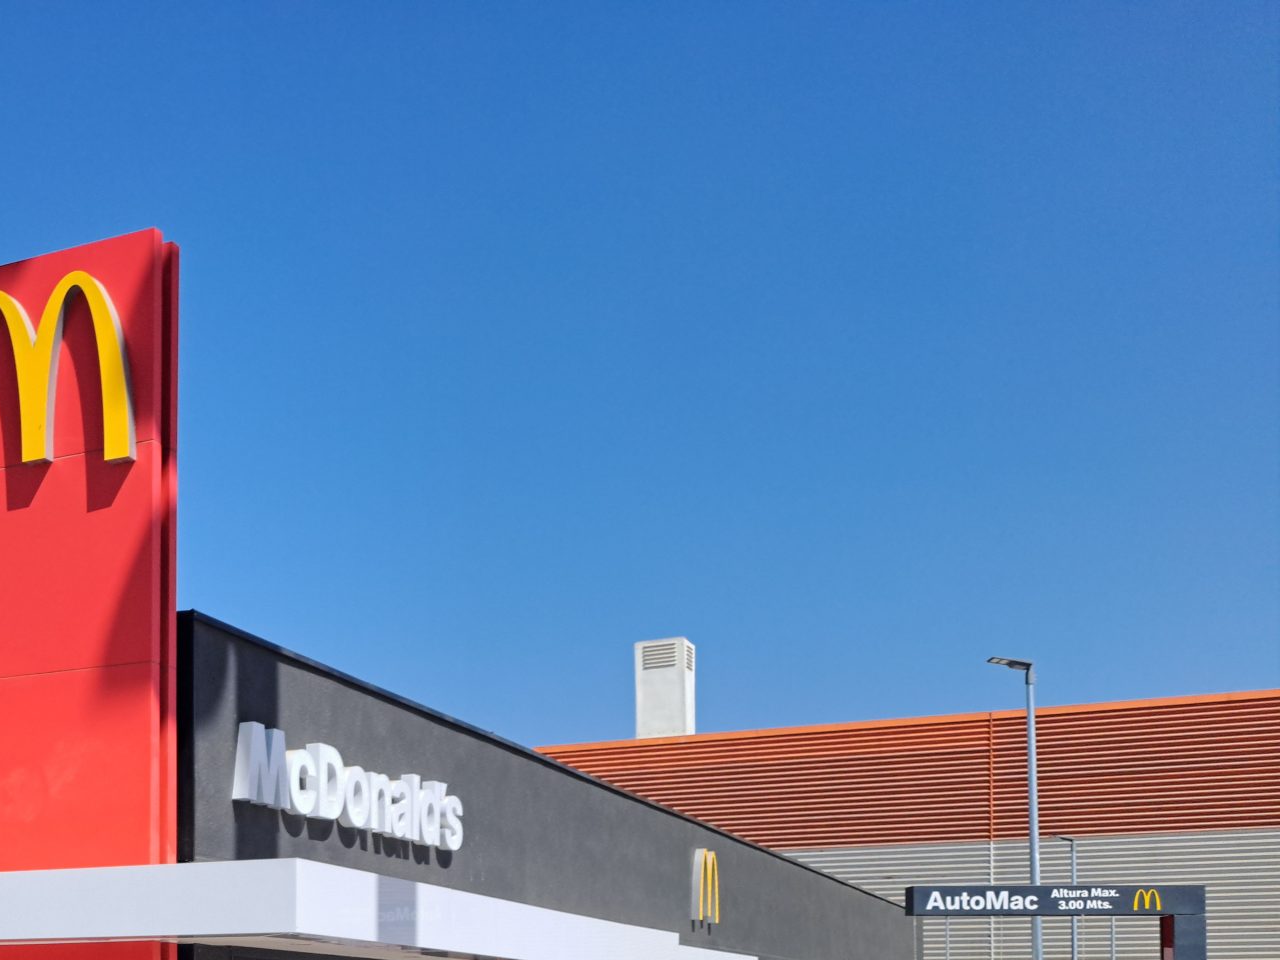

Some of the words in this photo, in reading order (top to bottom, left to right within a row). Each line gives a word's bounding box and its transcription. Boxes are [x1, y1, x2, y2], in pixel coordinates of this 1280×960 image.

[232, 721, 464, 851] McDonald's
[925, 890, 1039, 910] AutoMac
[1050, 888, 1089, 898] Altura
[1091, 887, 1119, 897] Max.
[1058, 900, 1084, 910] 3.00
[1086, 899, 1112, 909] Mts.
